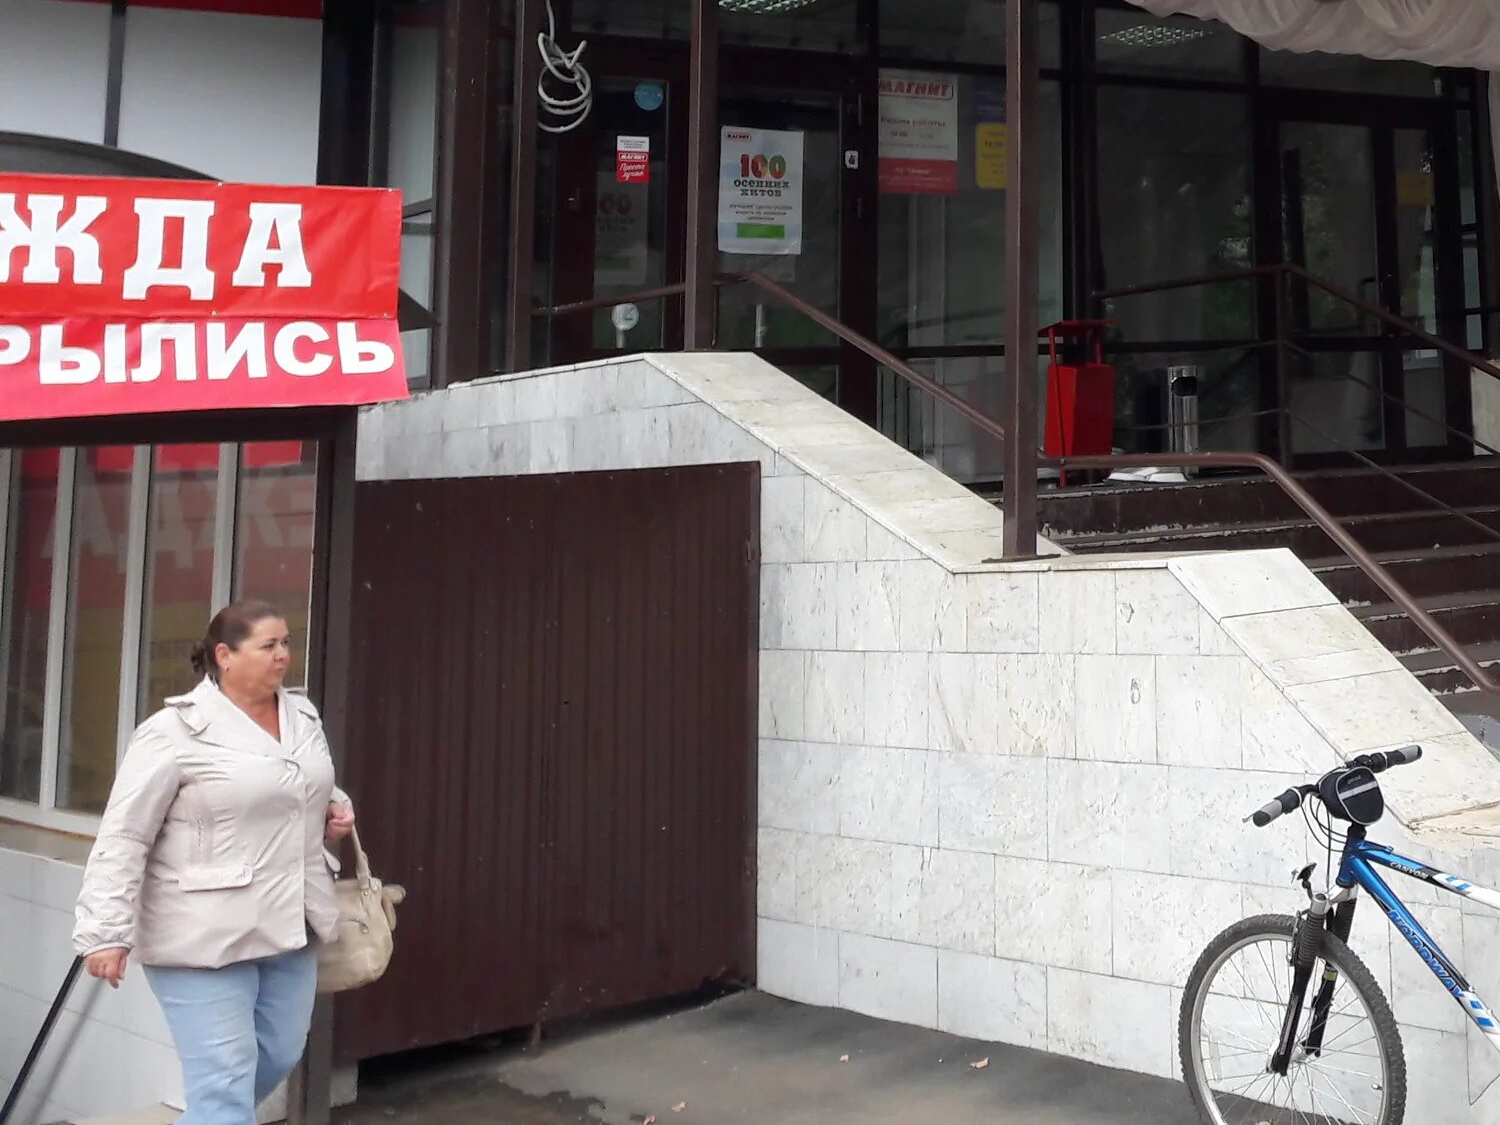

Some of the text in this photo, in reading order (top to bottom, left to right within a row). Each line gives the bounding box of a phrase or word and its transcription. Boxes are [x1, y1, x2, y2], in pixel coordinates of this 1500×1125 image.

[740, 153, 787, 179] 100
[1389, 860, 1429, 880] CANYON
[1387, 908, 1465, 998] NORDWAY
